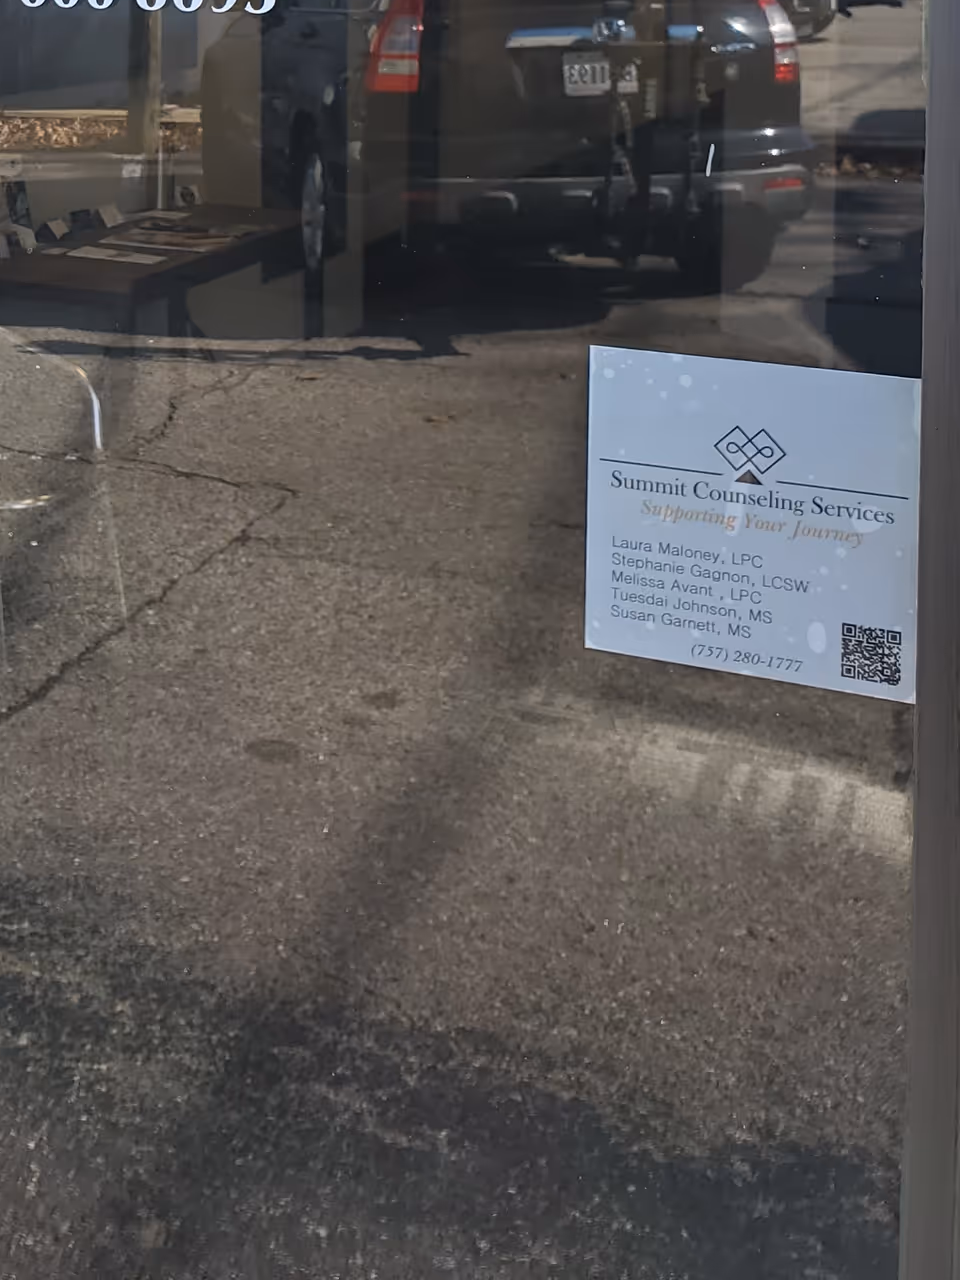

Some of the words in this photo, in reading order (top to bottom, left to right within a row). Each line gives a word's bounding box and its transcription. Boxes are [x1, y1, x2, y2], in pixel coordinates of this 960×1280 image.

[610, 470, 687, 498] Summit
[693, 480, 805, 515] Counseling
[811, 496, 896, 525] Services
[641, 499, 737, 531] Supporting
[742, 512, 786, 535] Your
[788, 520, 864, 549] Journey
[612, 536, 652, 552] Laura
[658, 542, 725, 565] Maloney,
[732, 552, 764, 569] LPC
[611, 553, 685, 576] Stephanie
[690, 565, 756, 587] Gagnon,
[762, 575, 811, 594] LCSW
[611, 571, 665, 590] Melissa
[671, 580, 714, 597] Avant
[730, 588, 762, 605] LPC
[610, 588, 668, 608] Tuesdai
[673, 598, 742, 620] Johnson,
[749, 609, 773, 624] MS
[610, 605, 655, 623] Susan
[661, 613, 721, 635] Garnett,
[728, 624, 752, 639] MS
[691, 644, 729, 662] (757)
[733, 651, 803, 672] 280-1777
